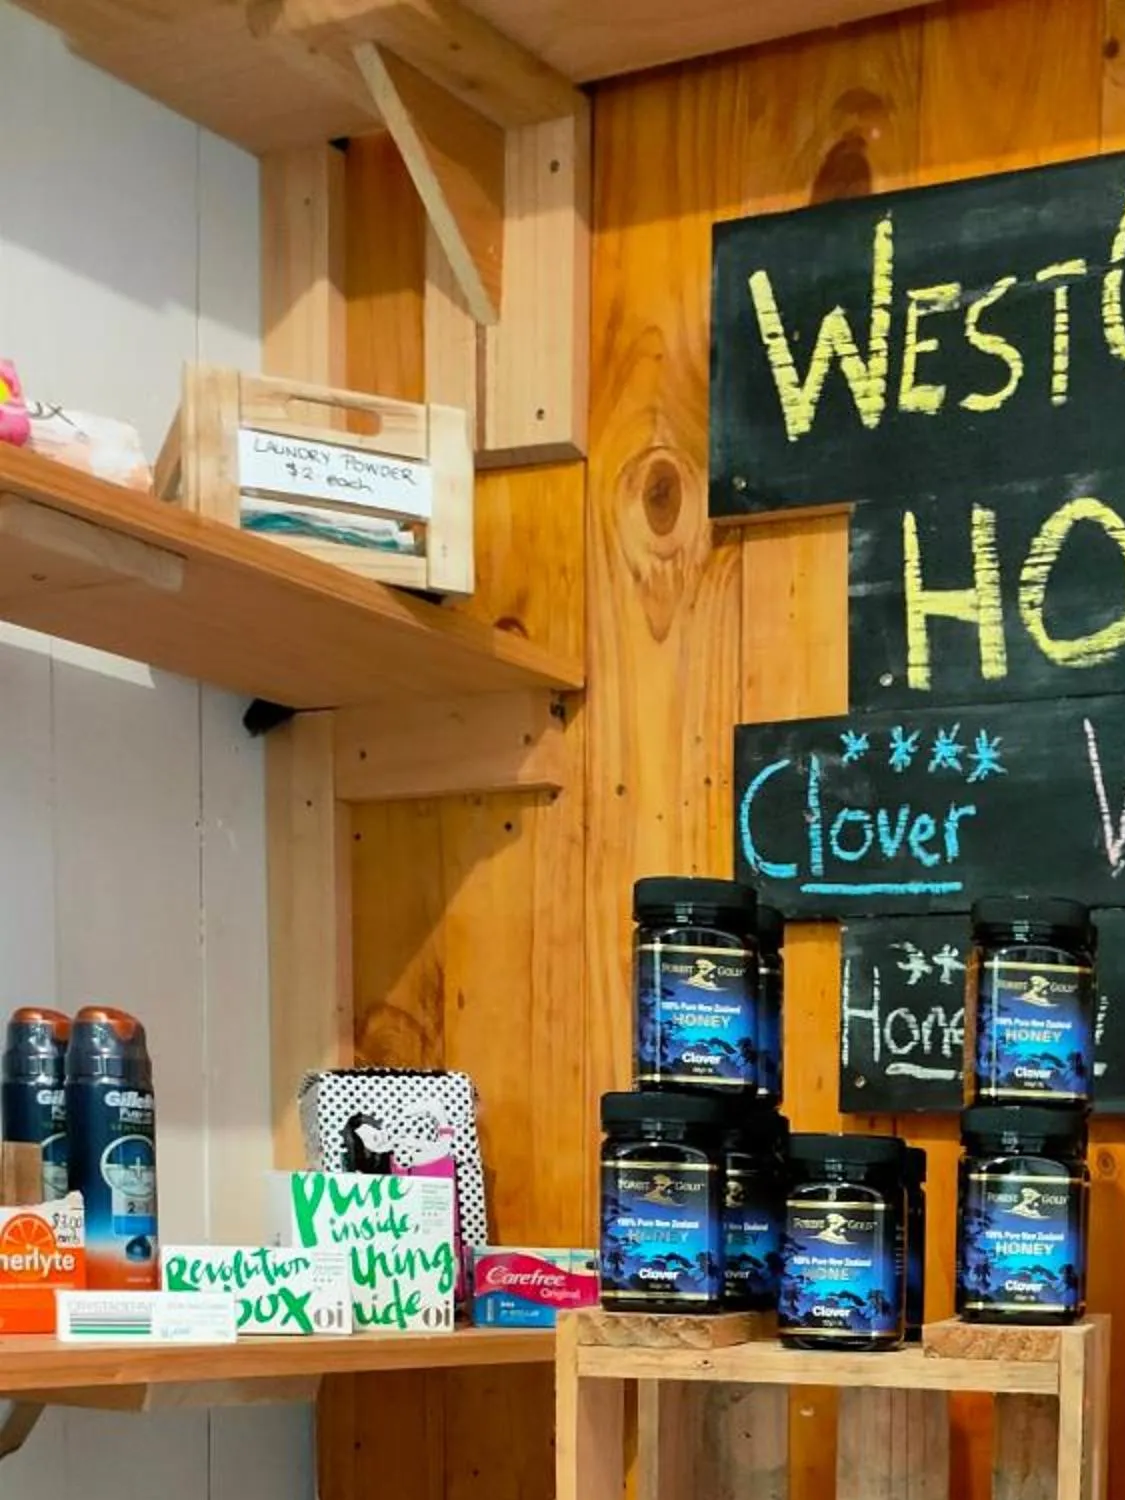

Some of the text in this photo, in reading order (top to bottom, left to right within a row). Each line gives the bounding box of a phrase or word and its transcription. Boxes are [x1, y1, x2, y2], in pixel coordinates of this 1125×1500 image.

[748, 212, 1086, 441] WEST
[253, 438, 417, 487] LAUNDRY POWDER
[739, 755, 977, 879] Clover
[671, 1013, 731, 1028] HONEY
[842, 958, 966, 1068] Hone
[1005, 1028, 1063, 1043] HONEY
[995, 1241, 1055, 1256] HONEY
[165, 1248, 311, 1292] Revolution
[351, 1241, 456, 1294] thing
[486, 1265, 567, 1287] Carefree
[639, 1268, 680, 1281] Clover
[314, 1301, 344, 1328] oi
[422, 1300, 451, 1328] oi
[812, 1304, 852, 1317] Clover
